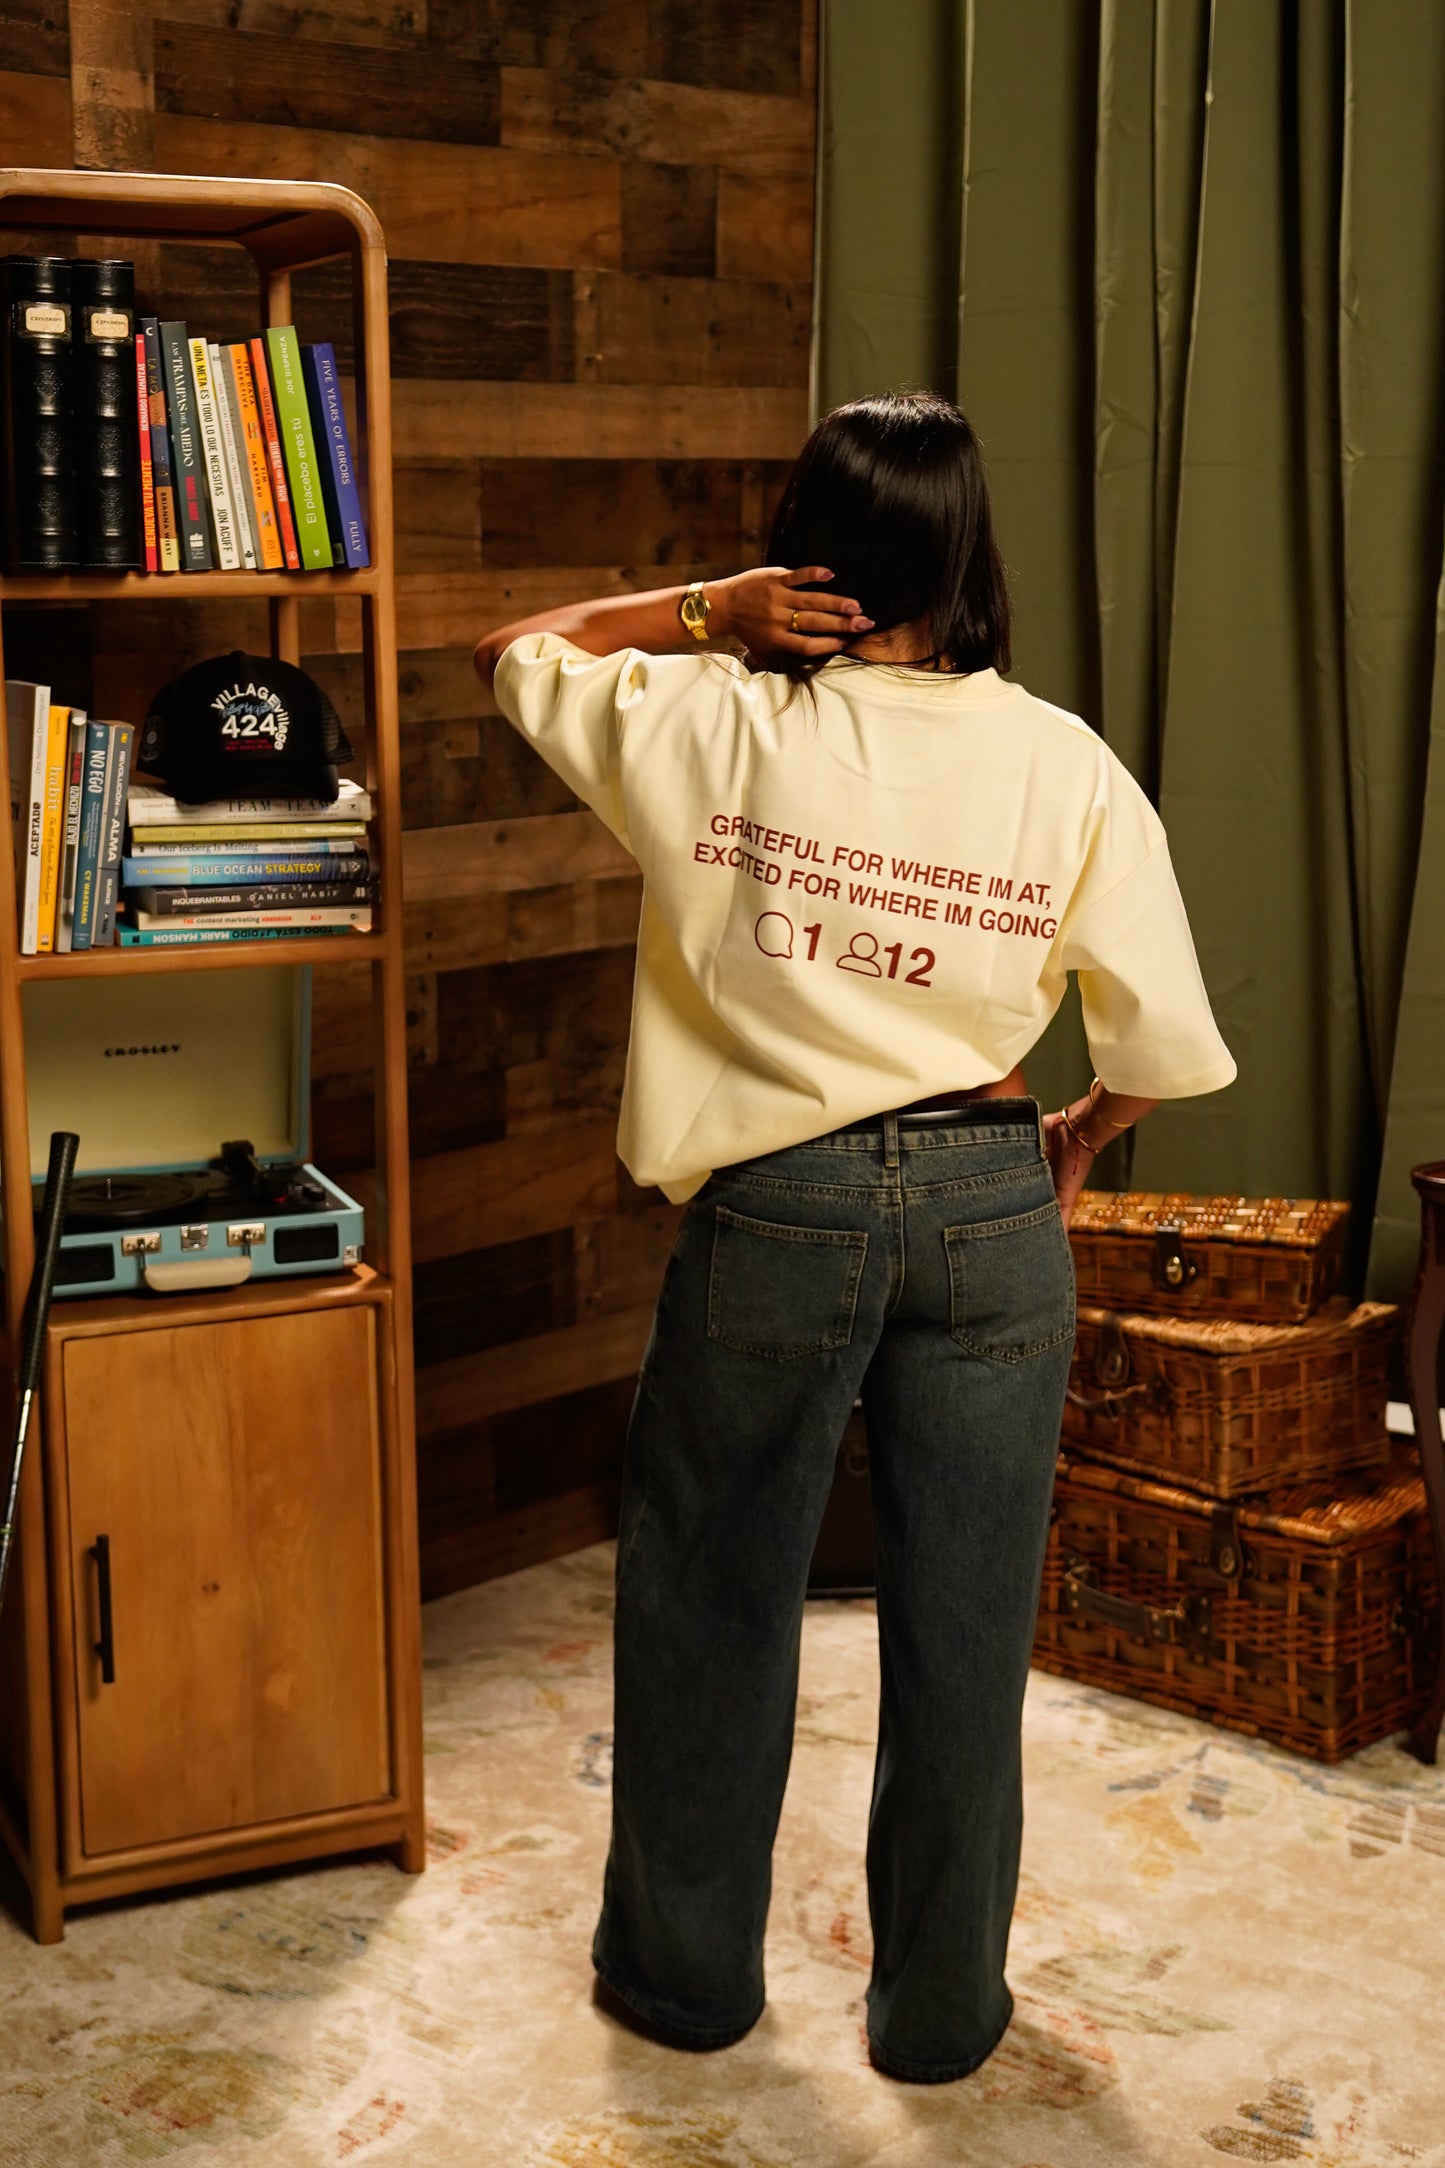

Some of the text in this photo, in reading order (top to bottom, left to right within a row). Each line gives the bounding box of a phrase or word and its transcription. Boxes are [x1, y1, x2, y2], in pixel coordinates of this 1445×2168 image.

[171, 342, 180, 356] LAS
[279, 336, 295, 395] JOE DISPENZA
[137, 363, 149, 431] BERNARDO STAMATEAS
[172, 356, 188, 411] TRAMPAS
[235, 358, 249, 409] DETECTIVE
[243, 360, 255, 405] THE DATA
[193, 345, 224, 497] UNA META ES TODO LO QUE NECESITAS
[322, 359, 351, 486] FIVE YEARS OF ERRORS
[180, 427, 194, 467] MIEDO
[250, 453, 263, 498] HARFORD
[260, 467, 268, 483] TIM
[290, 417, 317, 524] El placebo eres tú
[141, 460, 156, 547] RENUEVA TU MENTE
[160, 491, 172, 556] BRIANNA WIEST
[216, 508, 232, 552] JON ACUFF
[348, 520, 362, 552] FULLY
[210, 682, 281, 711] VILLAGE
[221, 713, 279, 739] 424
[89, 750, 106, 769] NO
[48, 766, 63, 811] habit
[87, 770, 105, 794] EGO
[114, 750, 126, 806] REVOLUCIÓN
[68, 785, 80, 815] HECHIZO
[226, 800, 271, 812] TEAM
[66, 824, 78, 845] BAJO
[67, 815, 78, 824] EL
[107, 818, 121, 862] ALMA
[158, 842, 259, 855] Our Iceberg Is Melting
[84, 870, 92, 881] CY
[192, 865, 220, 875] BLUE
[223, 864, 262, 875] OCEAN
[265, 863, 321, 874] STRATEGY
[710, 814, 1051, 910] GRATEFUL FOR WHERE IM AT,
[80, 882, 91, 925] WAKEMAN
[172, 895, 241, 906] INQUEBRANTABLES
[249, 890, 339, 902] DANIEL HABIF
[693, 841, 1058, 940] EXCITED FOR WHERE IM GOING
[153, 931, 230, 943] MARK MANSON
[224, 917, 260, 925] marketing
[303, 925, 334, 934] TODO
[803, 922, 936, 988] 1 12
[104, 1043, 180, 1057] CROSLEY
